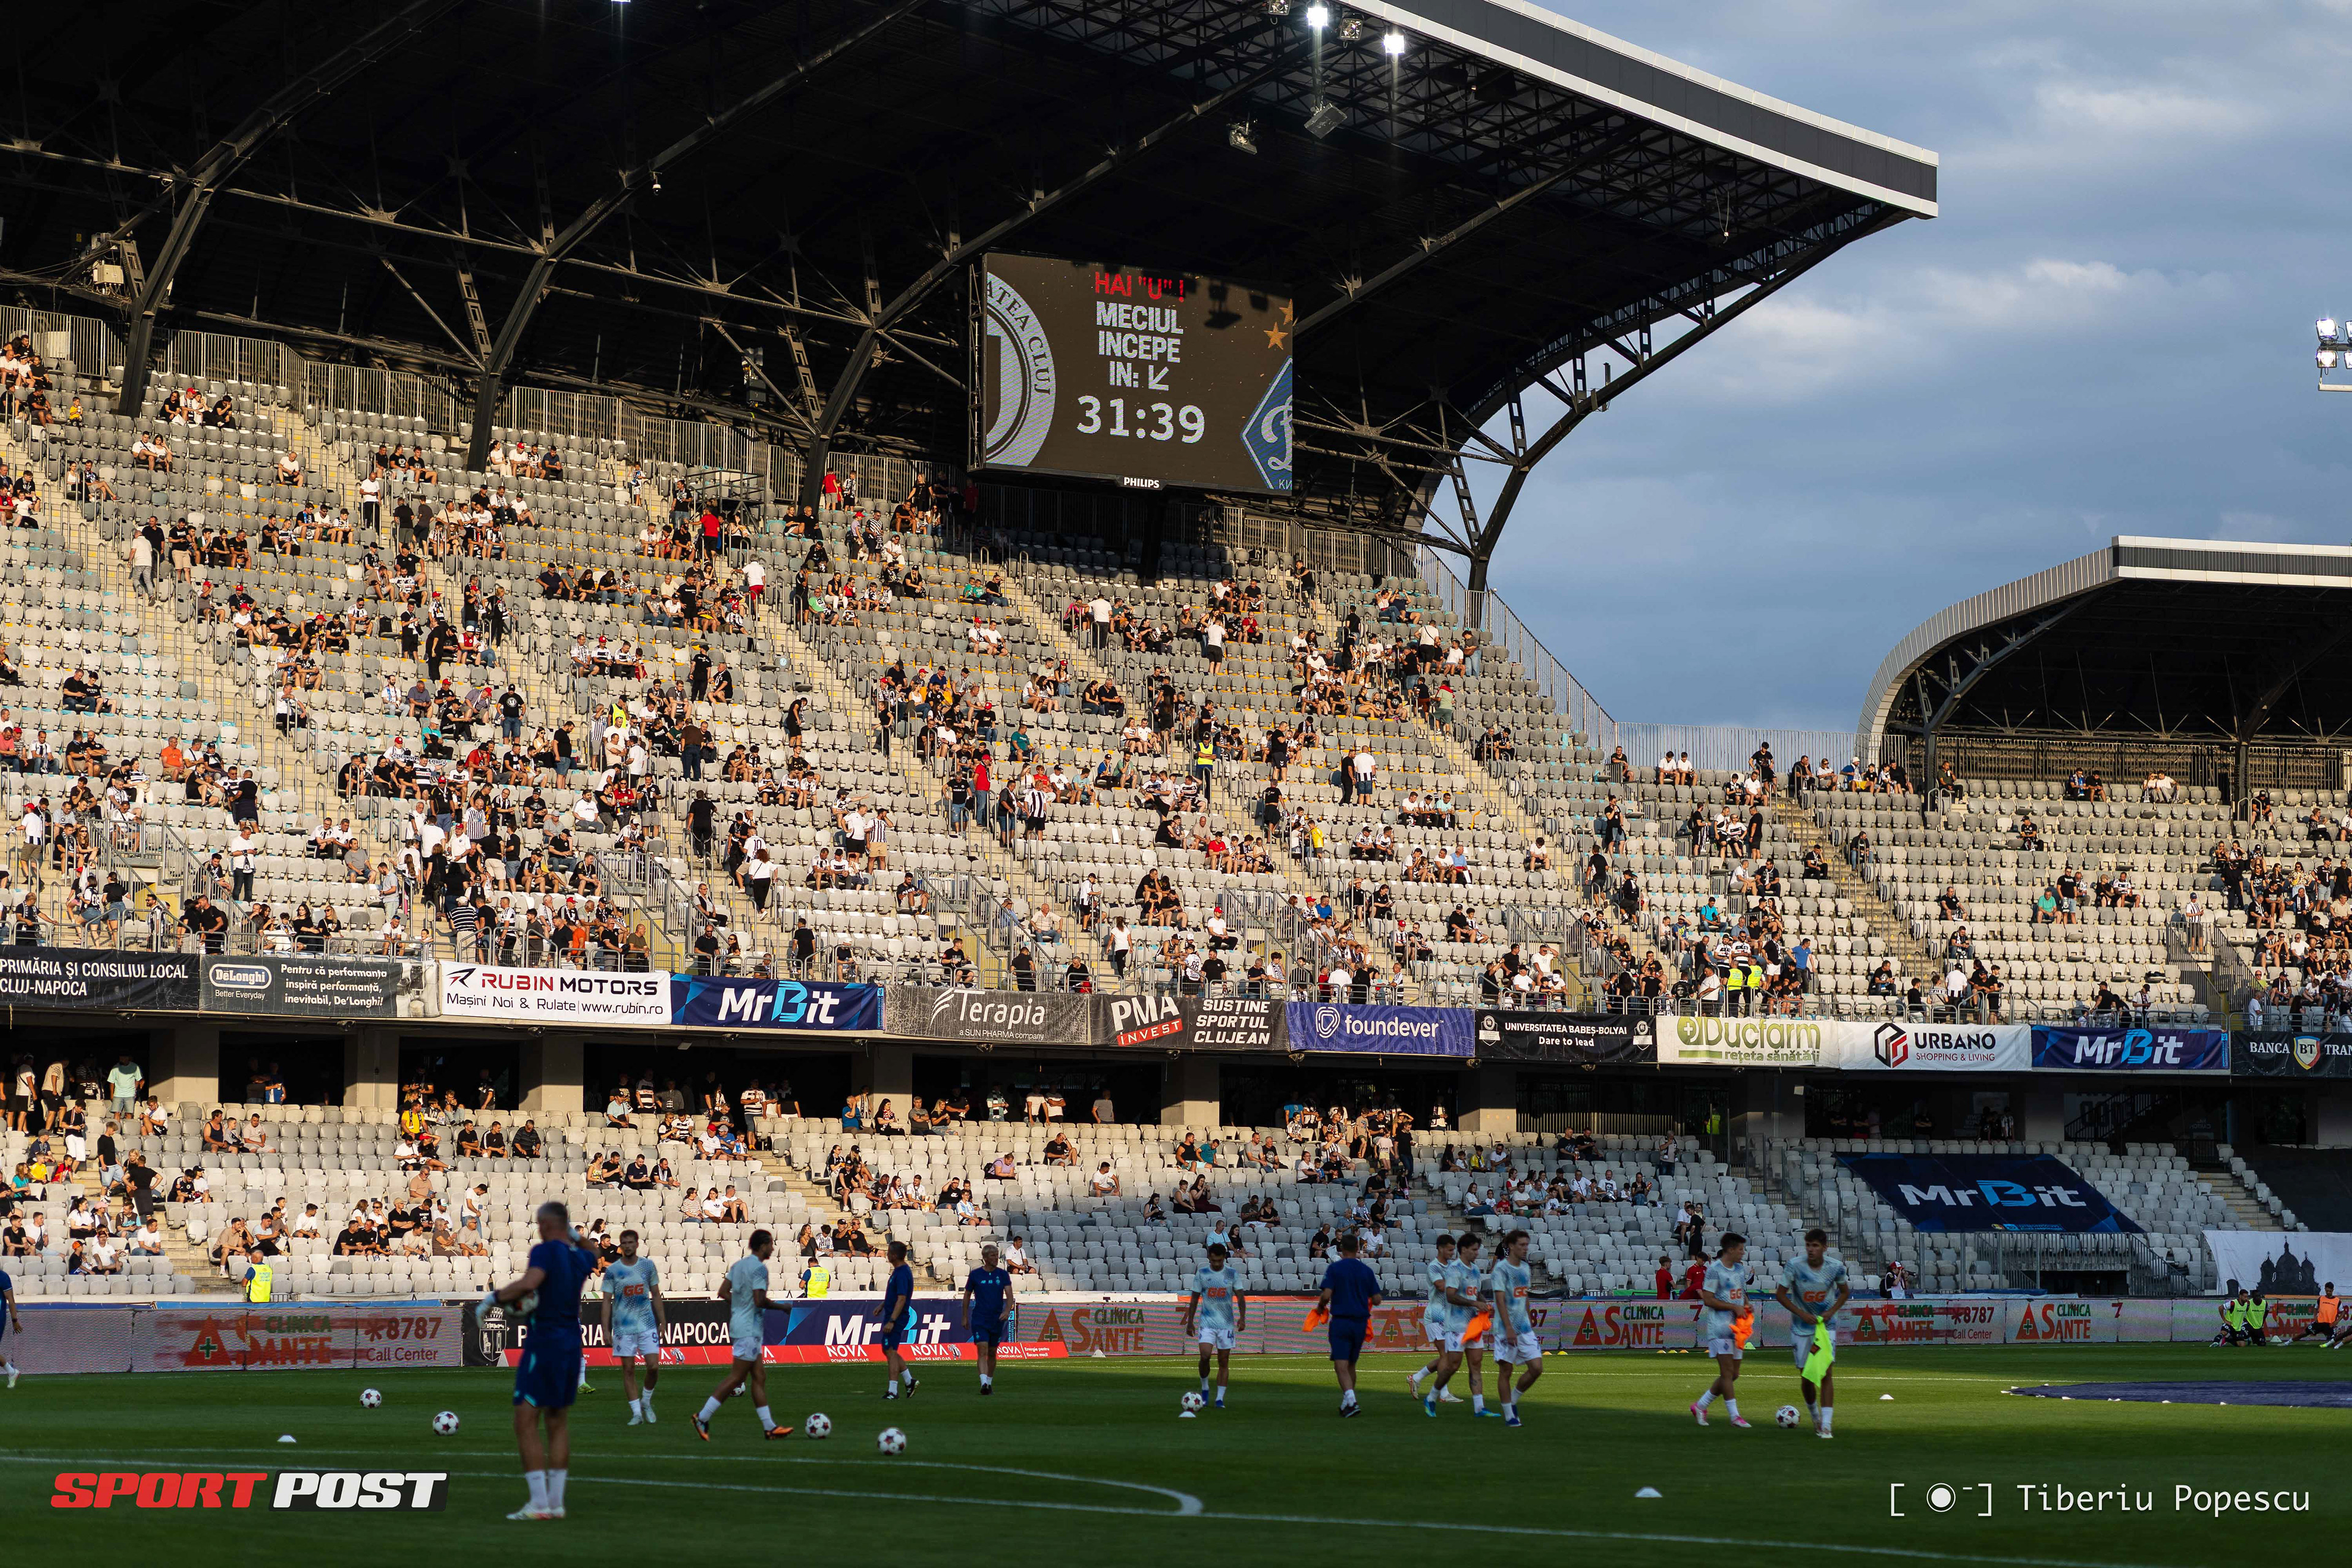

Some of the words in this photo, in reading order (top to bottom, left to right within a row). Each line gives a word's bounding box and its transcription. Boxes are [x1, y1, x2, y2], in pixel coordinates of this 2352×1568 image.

[1095, 271, 1132, 297] HAI
[1096, 301, 1184, 334] MECIUL
[1098, 330, 1181, 363] INCEPE
[1028, 336, 1050, 395] CLUJ
[1109, 360, 1139, 388] IN:
[1076, 395, 1205, 443] 31:39
[1123, 477, 1160, 489] PHILIPS
[0, 957, 61, 976] PRIMĂRIA
[81, 962, 148, 979] CONSILIUL
[150, 964, 189, 979] LOCAL
[281, 964, 312, 975] Pentru
[314, 966, 326, 976] că
[0, 978, 88, 997] CLUJ-NAPOCA
[285, 979, 317, 992] inspiră
[482, 973, 554, 992] RUBIN
[560, 978, 658, 996] MOTORS
[215, 989, 234, 999] Better
[235, 990, 265, 1001] Everyday
[284, 993, 332, 1006] inevitabil,
[492, 997, 513, 1008] Noi
[520, 998, 530, 1009] &
[537, 999, 576, 1011] Rulate
[581, 1003, 663, 1015] www.rubin.ro
[717, 981, 840, 1024] MrBit
[952, 988, 1046, 1030] Terapia
[1110, 995, 1180, 1032] PMA
[1196, 1015, 1269, 1029] SPORTUL
[1505, 1022, 1567, 1034] UNIVERSITATEA
[982, 1030, 1014, 1038] PHARMA
[1014, 1032, 1044, 1041] company
[1194, 1031, 1271, 1045] CLUJEAN
[1704, 1016, 1820, 1049] Ducfarm
[1539, 1036, 1561, 1046] Dare
[1575, 1038, 1595, 1047] lead
[1914, 1033, 1996, 1050] URBANO
[2073, 1029, 2184, 1064] MrBit
[2250, 1042, 2290, 1054] BANCA
[2299, 1044, 2315, 1054] BT
[1916, 1053, 1958, 1062] SHOPPING
[1968, 1054, 1995, 1063] LIVING
[1898, 1180, 2087, 1207] MrBit
[623, 1283, 644, 1297] GG
[1208, 1287, 1226, 1298] GG
[1730, 1289, 1742, 1299] GG
[1804, 1291, 1826, 1302] GG
[1897, 1305, 1934, 1318] CLINICA
[266, 1316, 331, 1333] CLINICA
[1952, 1329, 1966, 1340] Call
[1967, 1329, 1992, 1340] Center
[366, 1347, 391, 1362] Call
[395, 1347, 438, 1362] Center
[826, 1344, 868, 1357] NOVA
[911, 1344, 949, 1356] NOVA
[997, 1346, 1021, 1354] NOVA
